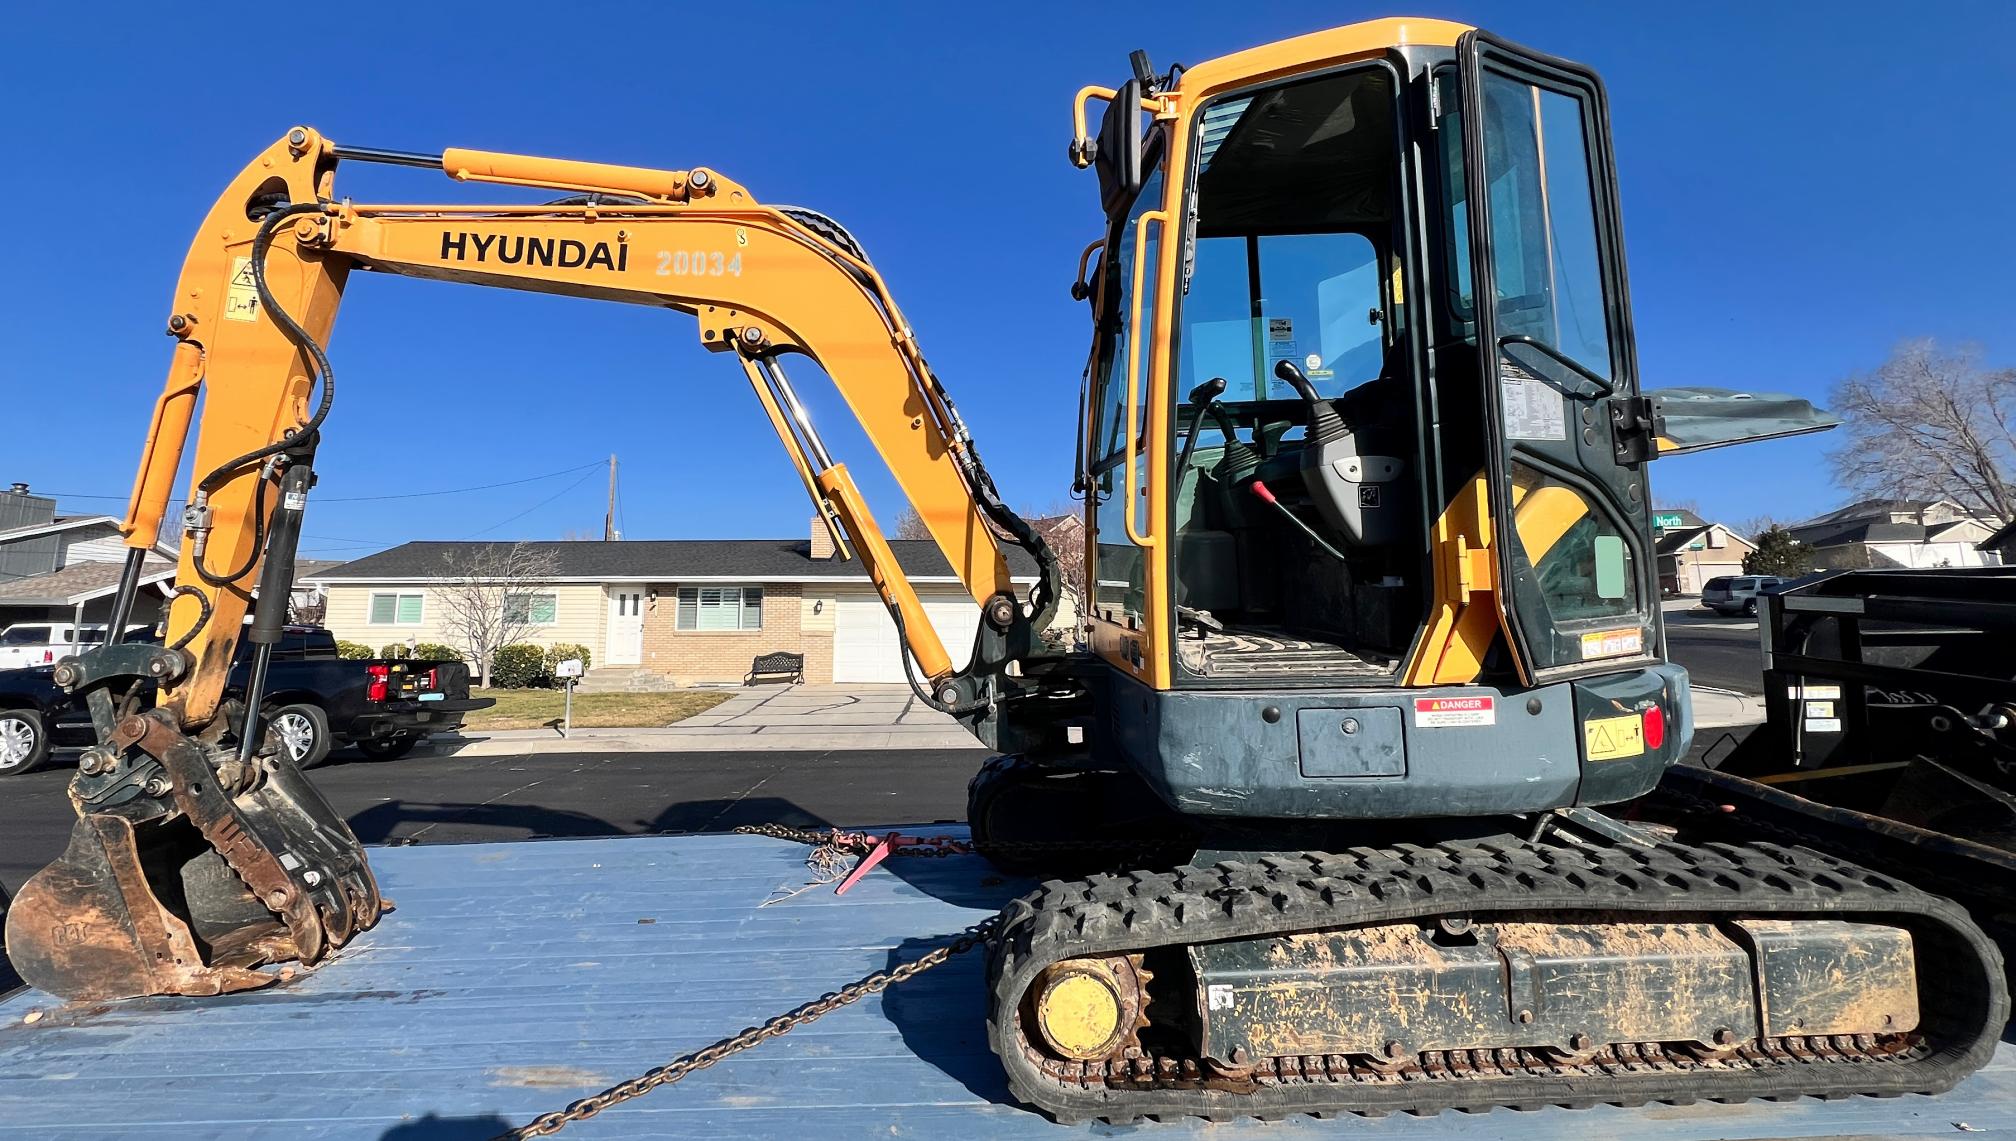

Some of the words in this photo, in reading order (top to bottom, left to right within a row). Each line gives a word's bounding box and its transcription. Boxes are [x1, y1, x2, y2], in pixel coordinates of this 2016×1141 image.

[441, 231, 628, 272] HYUNDAI
[656, 250, 743, 277] 20034
[1656, 515, 1683, 527] North
[1440, 699, 1482, 709] DANGER
